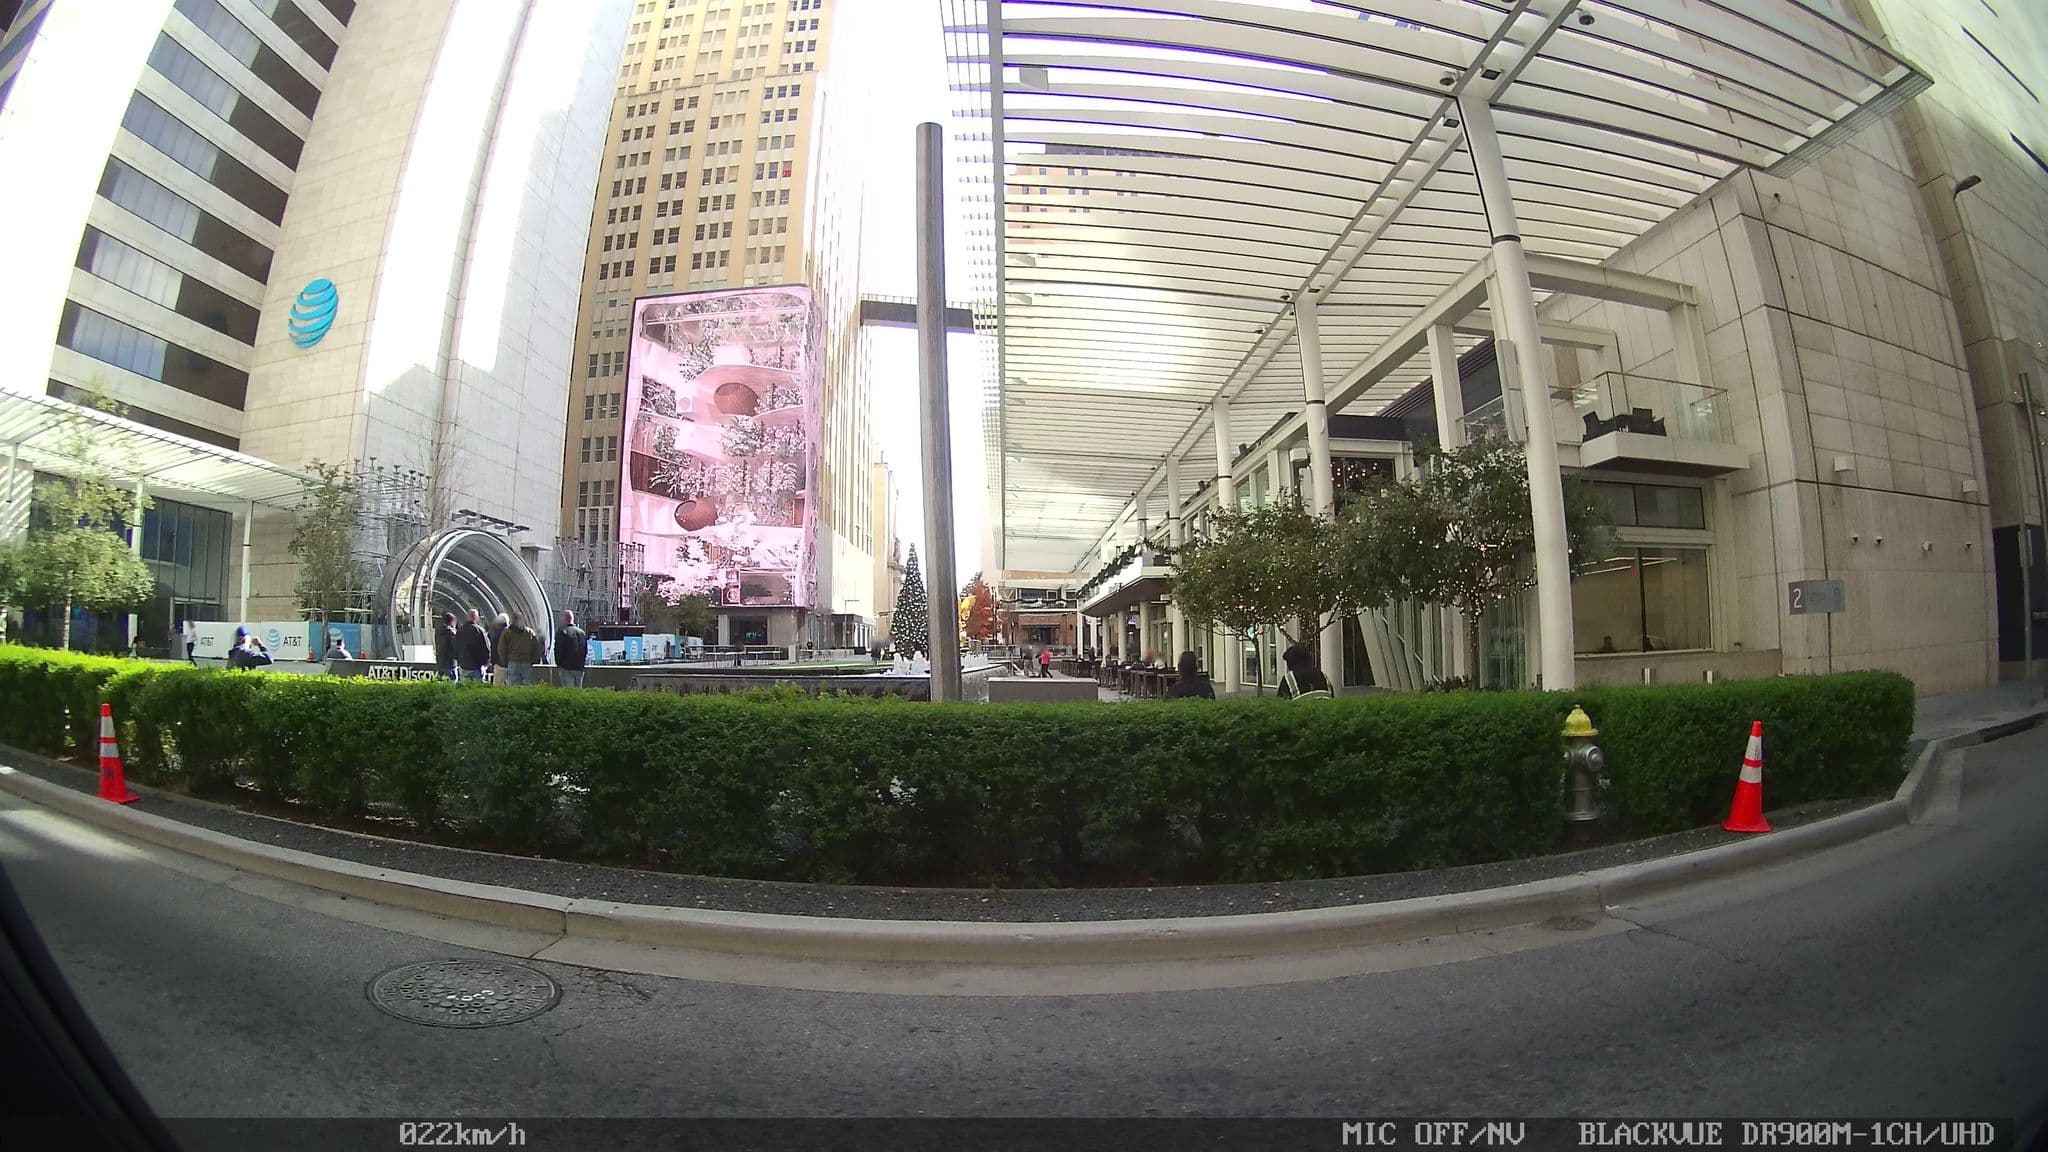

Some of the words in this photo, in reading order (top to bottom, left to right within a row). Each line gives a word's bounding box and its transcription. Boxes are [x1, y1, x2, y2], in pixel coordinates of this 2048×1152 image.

[1793, 588, 1802, 609] 2
[283, 636, 302, 647] AT&T
[367, 665, 398, 681] AT&T
[400, 666, 439, 681] Discov
